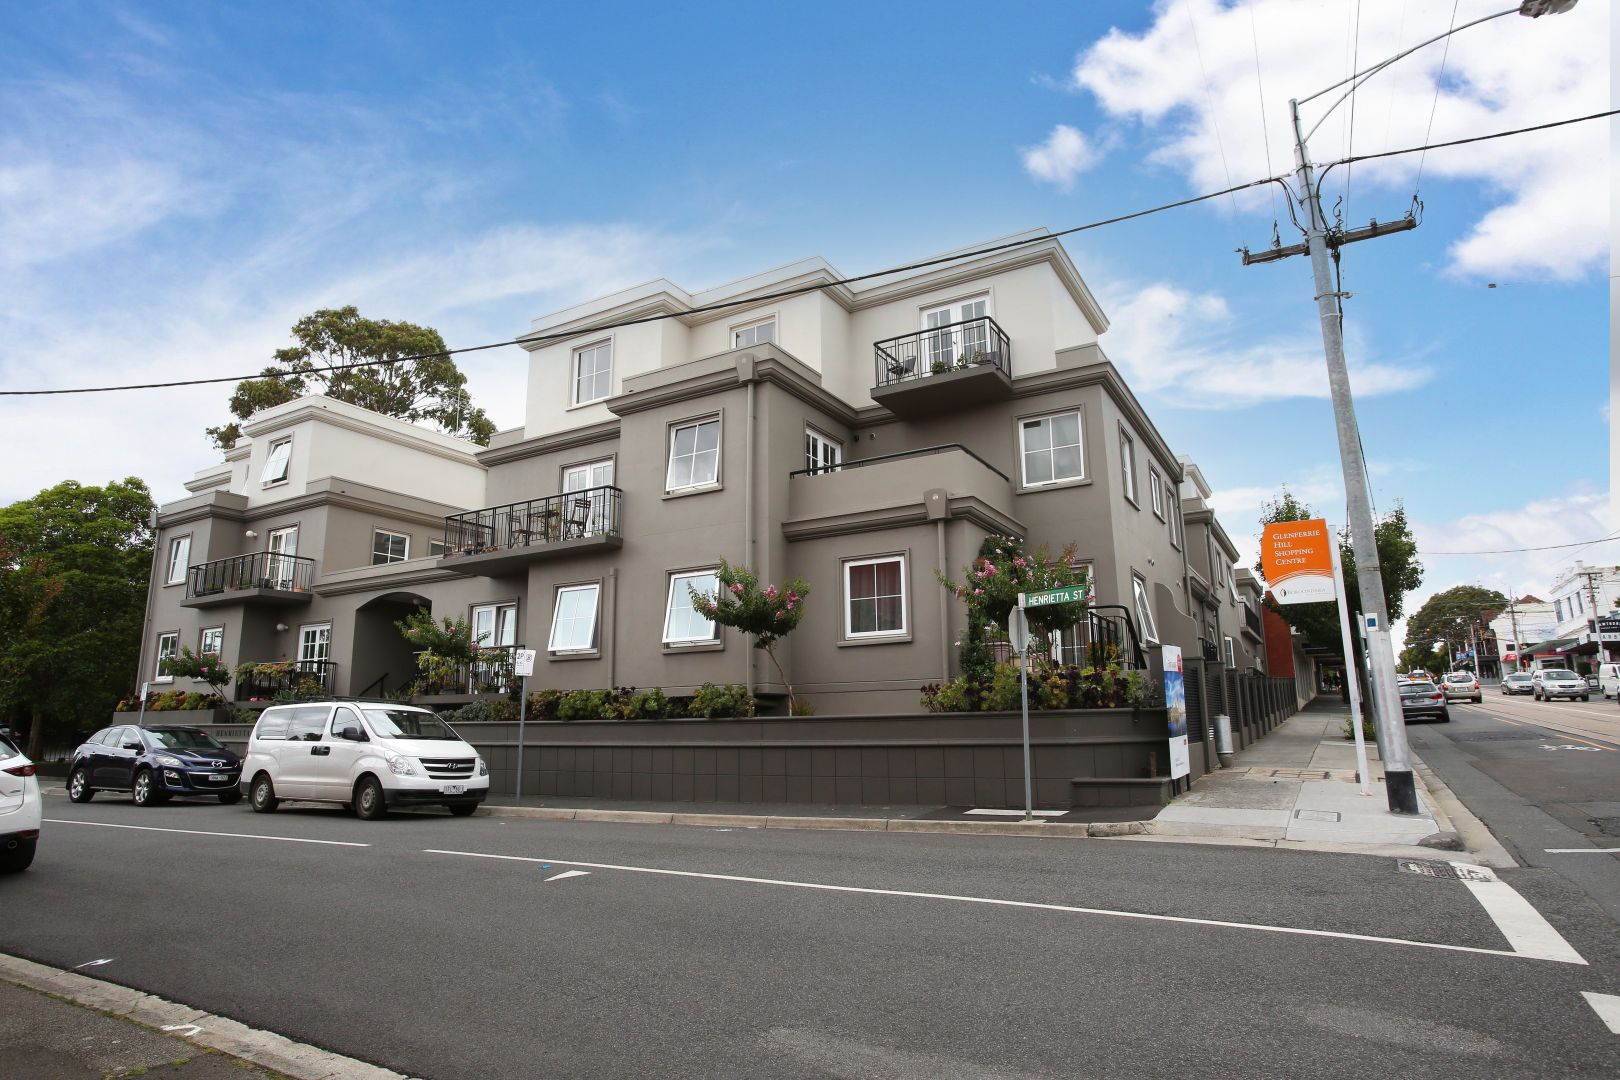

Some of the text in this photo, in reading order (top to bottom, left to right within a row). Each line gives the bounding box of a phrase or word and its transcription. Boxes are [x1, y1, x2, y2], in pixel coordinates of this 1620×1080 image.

[1273, 530, 1320, 540] GLENFERRIE
[1274, 548, 1314, 557] SHOPPING
[1275, 558, 1307, 566] CENTRE
[1028, 590, 1083, 606] HENRIETTA ST
